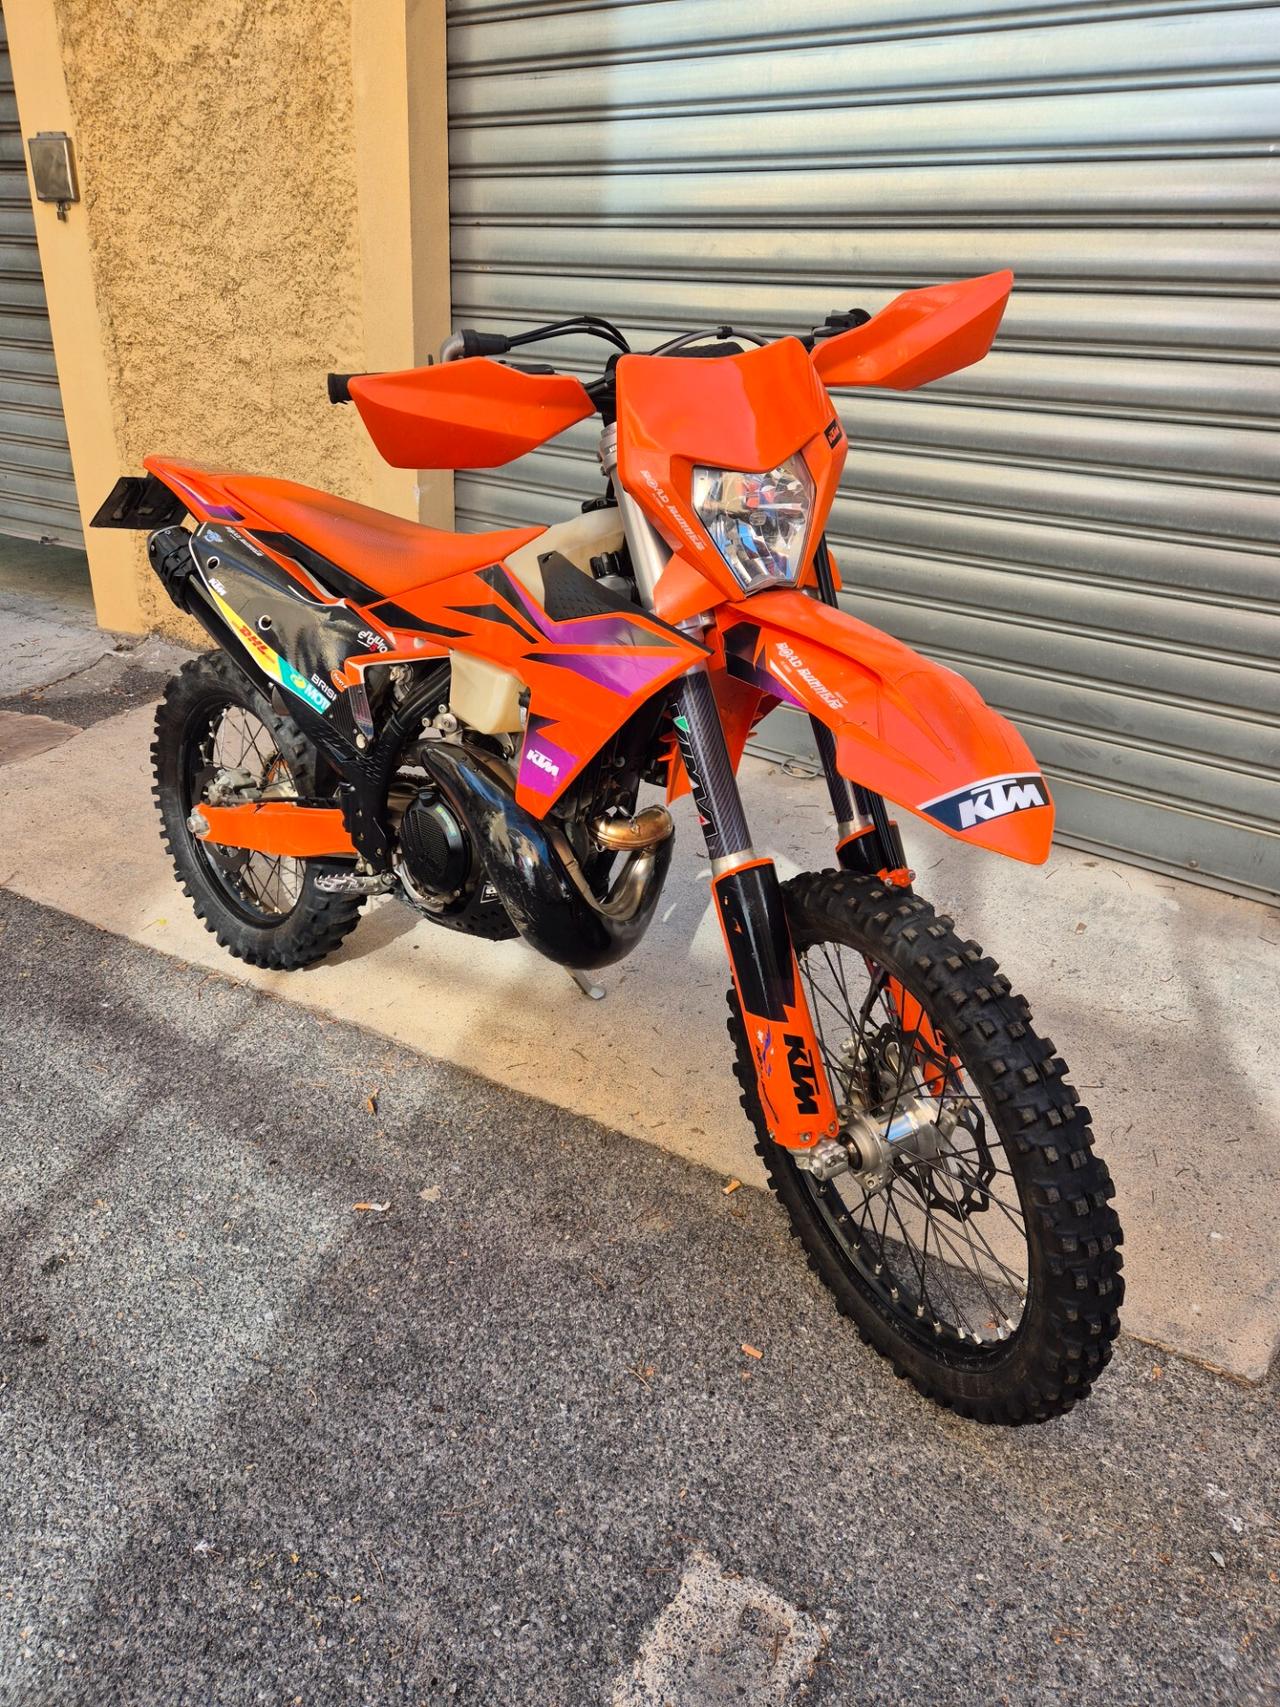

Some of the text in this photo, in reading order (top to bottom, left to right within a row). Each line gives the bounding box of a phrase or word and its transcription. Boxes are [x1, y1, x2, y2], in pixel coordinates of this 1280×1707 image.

[640, 470, 670, 504] ROAD
[208, 577, 227, 596] KTM
[239, 624, 270, 655] DHL
[775, 641, 802, 668] ROAD
[304, 684, 331, 710] MOT
[526, 748, 560, 777] KTM
[958, 778, 1045, 829] KTM
[783, 1033, 821, 1115] KTM
